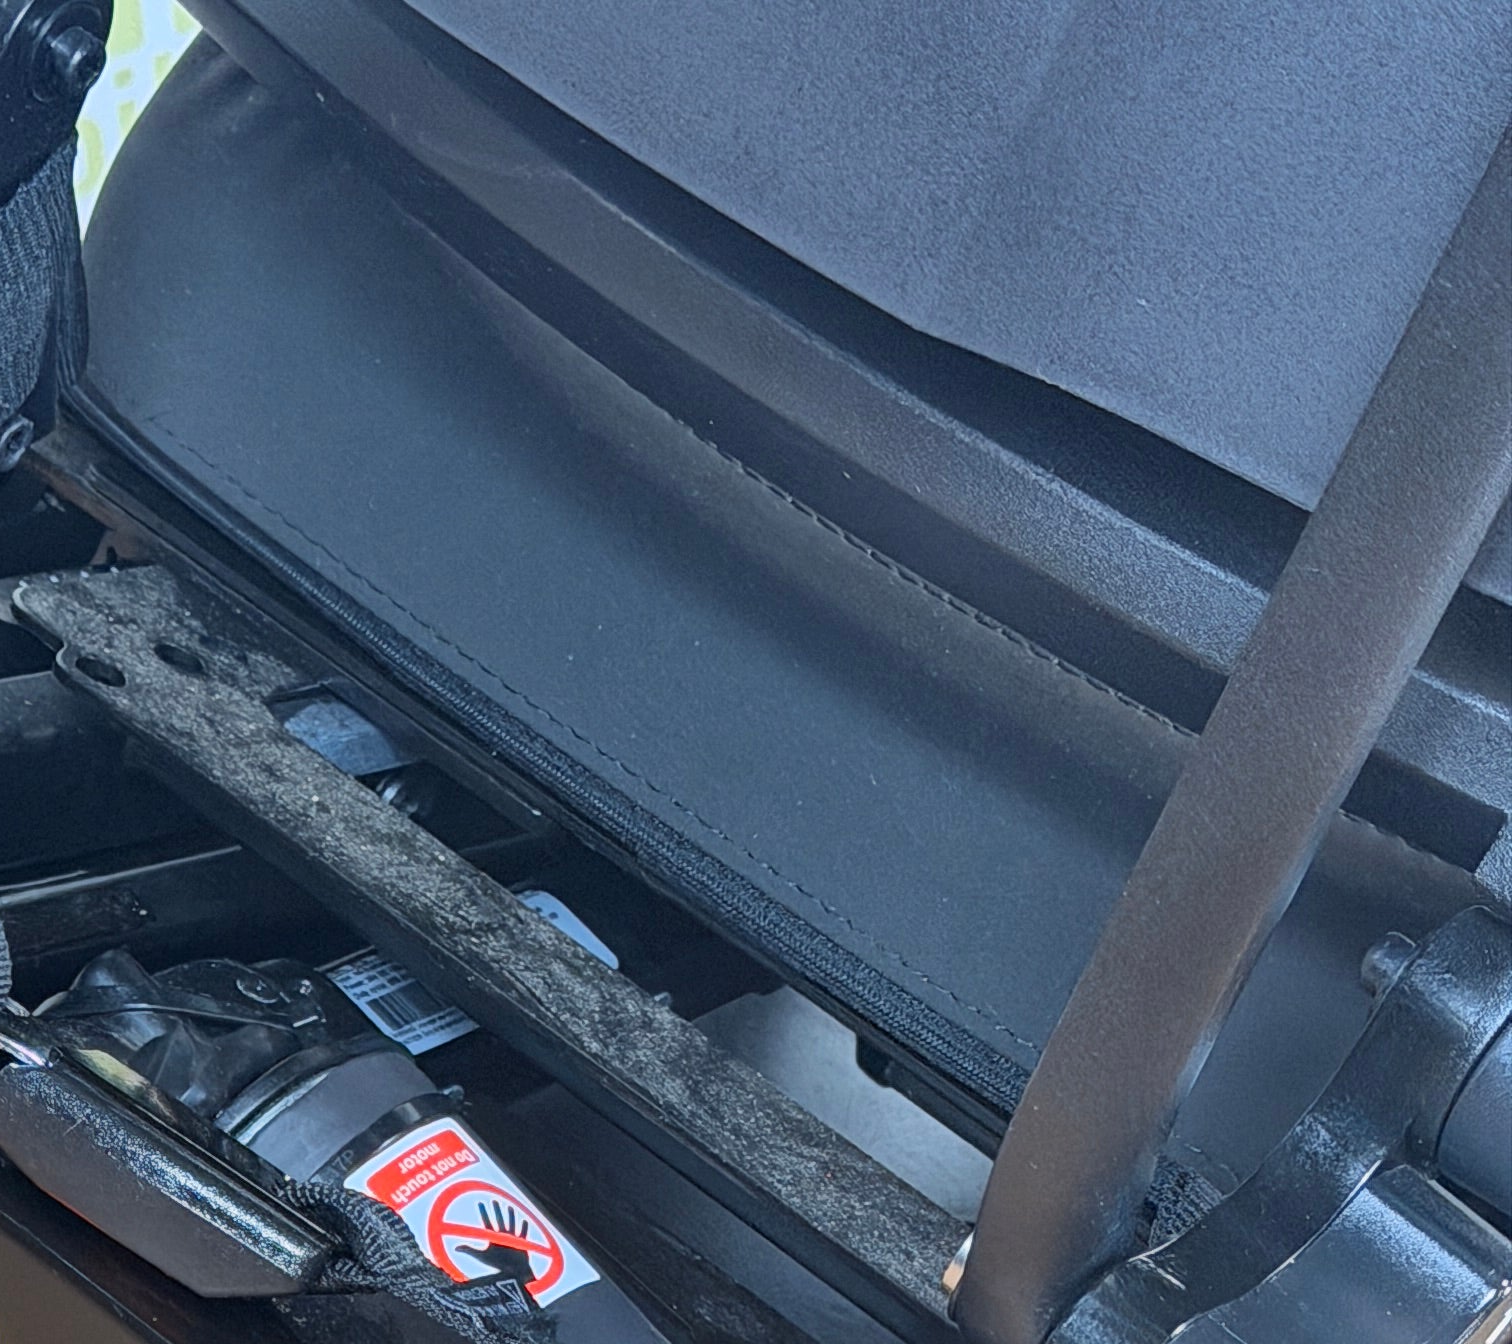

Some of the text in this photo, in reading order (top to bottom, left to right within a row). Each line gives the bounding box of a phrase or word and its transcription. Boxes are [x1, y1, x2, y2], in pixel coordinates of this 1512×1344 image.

[391, 1148, 476, 1203] Do not touch
[398, 1142, 441, 1174] motor
